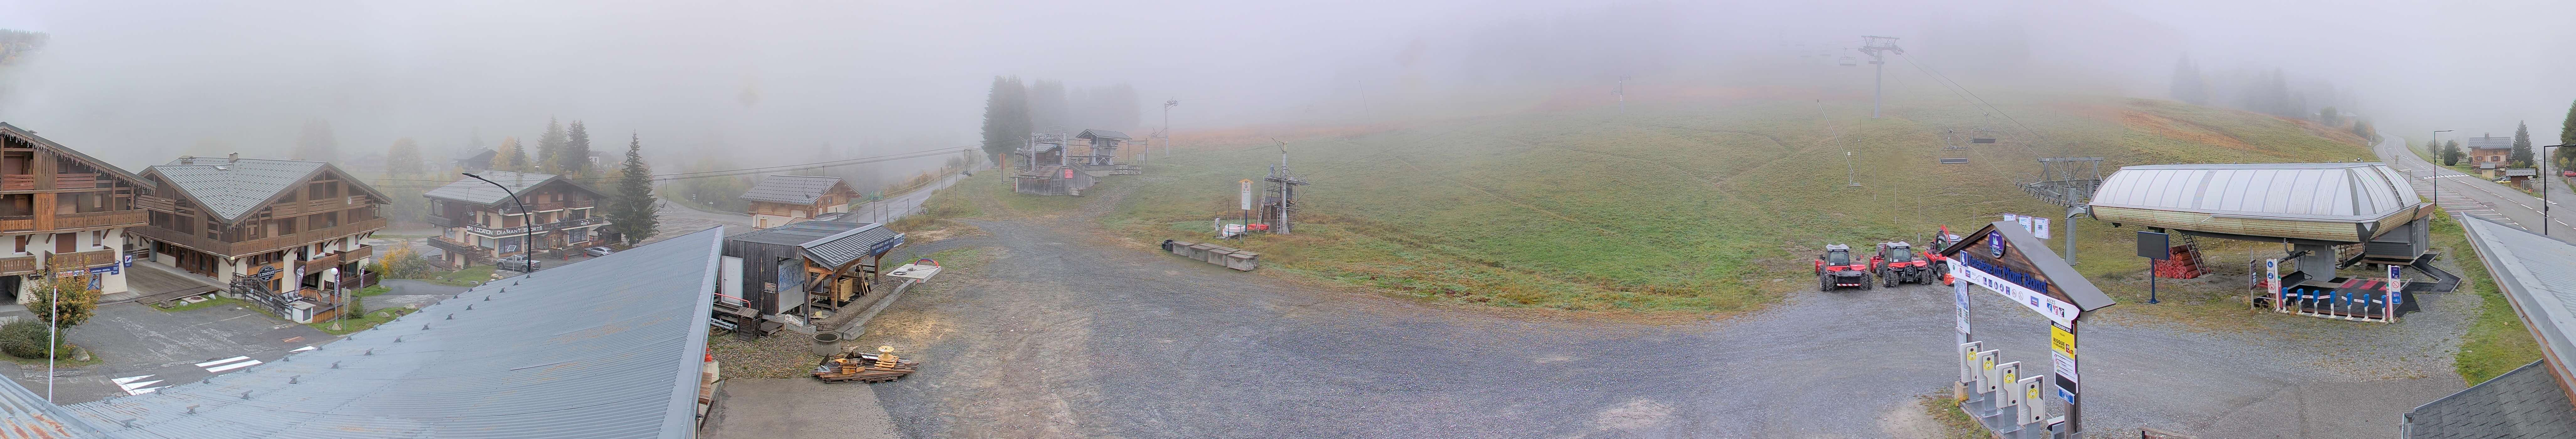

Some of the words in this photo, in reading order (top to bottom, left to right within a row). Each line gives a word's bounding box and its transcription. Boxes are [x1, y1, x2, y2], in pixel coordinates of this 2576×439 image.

[1994, 265, 2002, 276] du
[2004, 265, 2023, 284] Mont
[2024, 273, 2047, 294] Rond
[2054, 322, 2071, 333] AUJOURD'HUI
[2053, 337, 2065, 346] RISQUE
